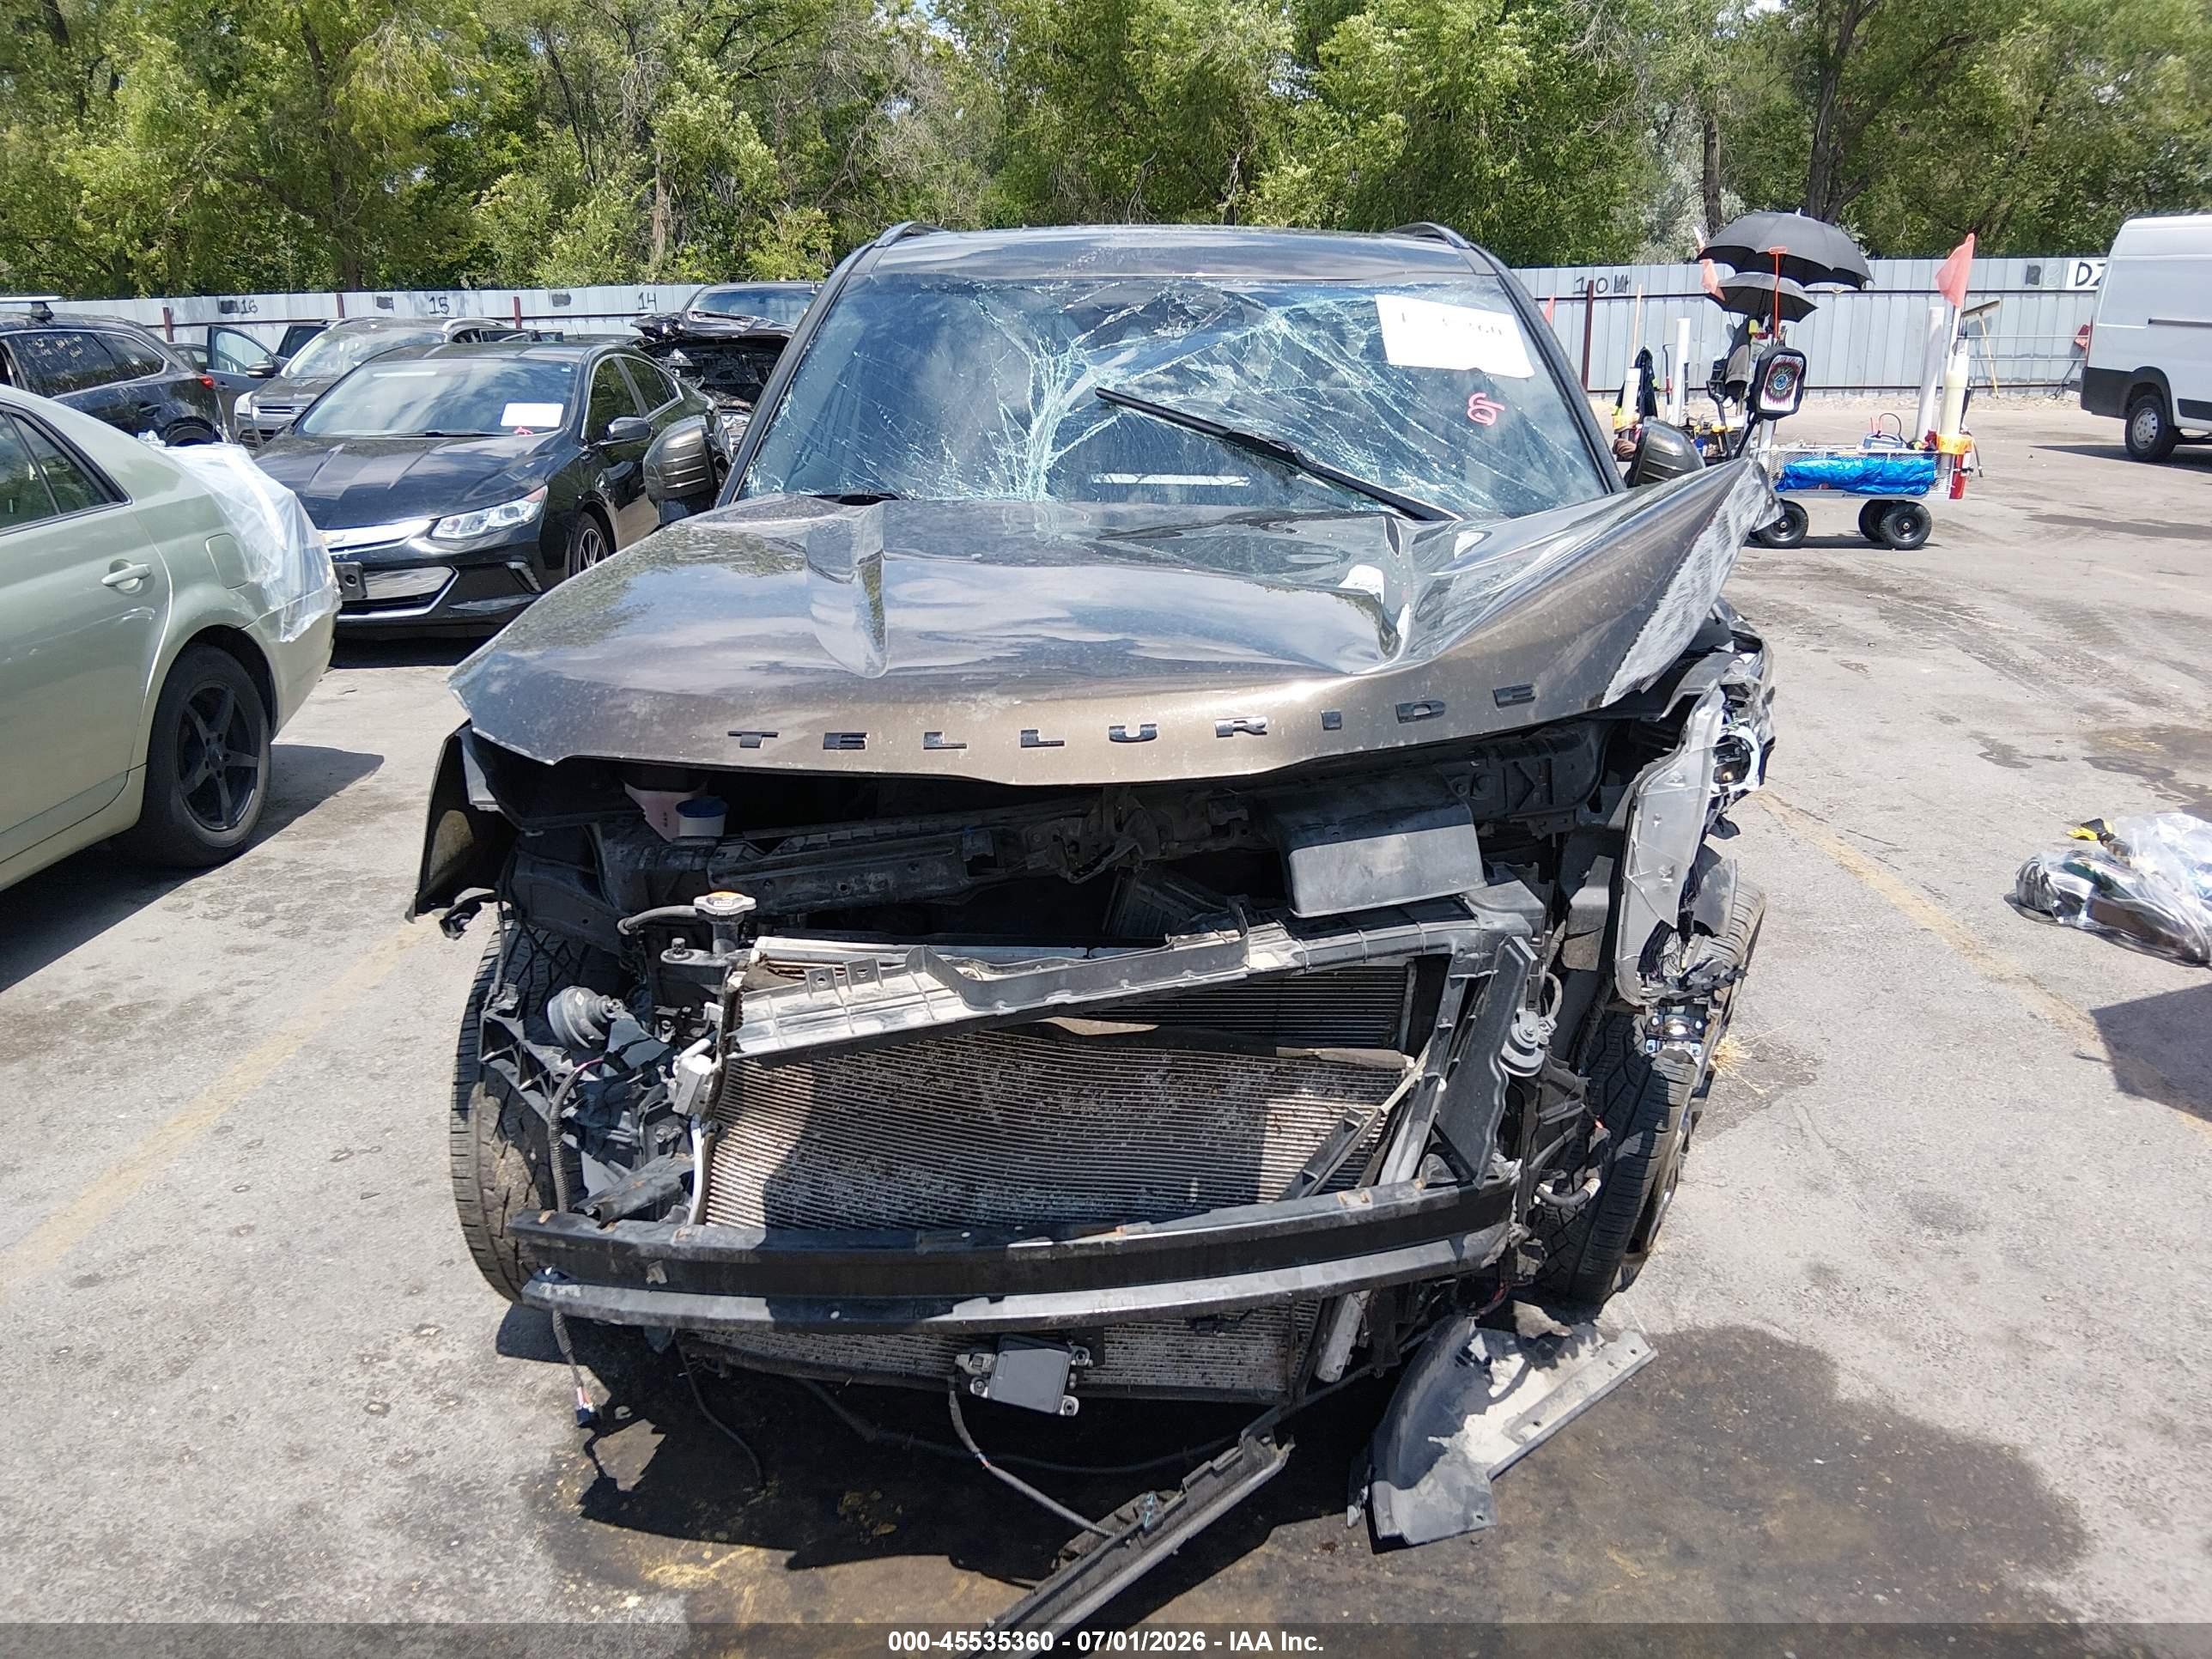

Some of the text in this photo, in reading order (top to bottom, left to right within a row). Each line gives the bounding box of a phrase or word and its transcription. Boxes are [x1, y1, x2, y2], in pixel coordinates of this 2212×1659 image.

[240, 300, 258, 313] 16
[429, 296, 449, 315] 15
[638, 292, 657, 312] 14
[728, 684, 1536, 750] TELLURIDE
